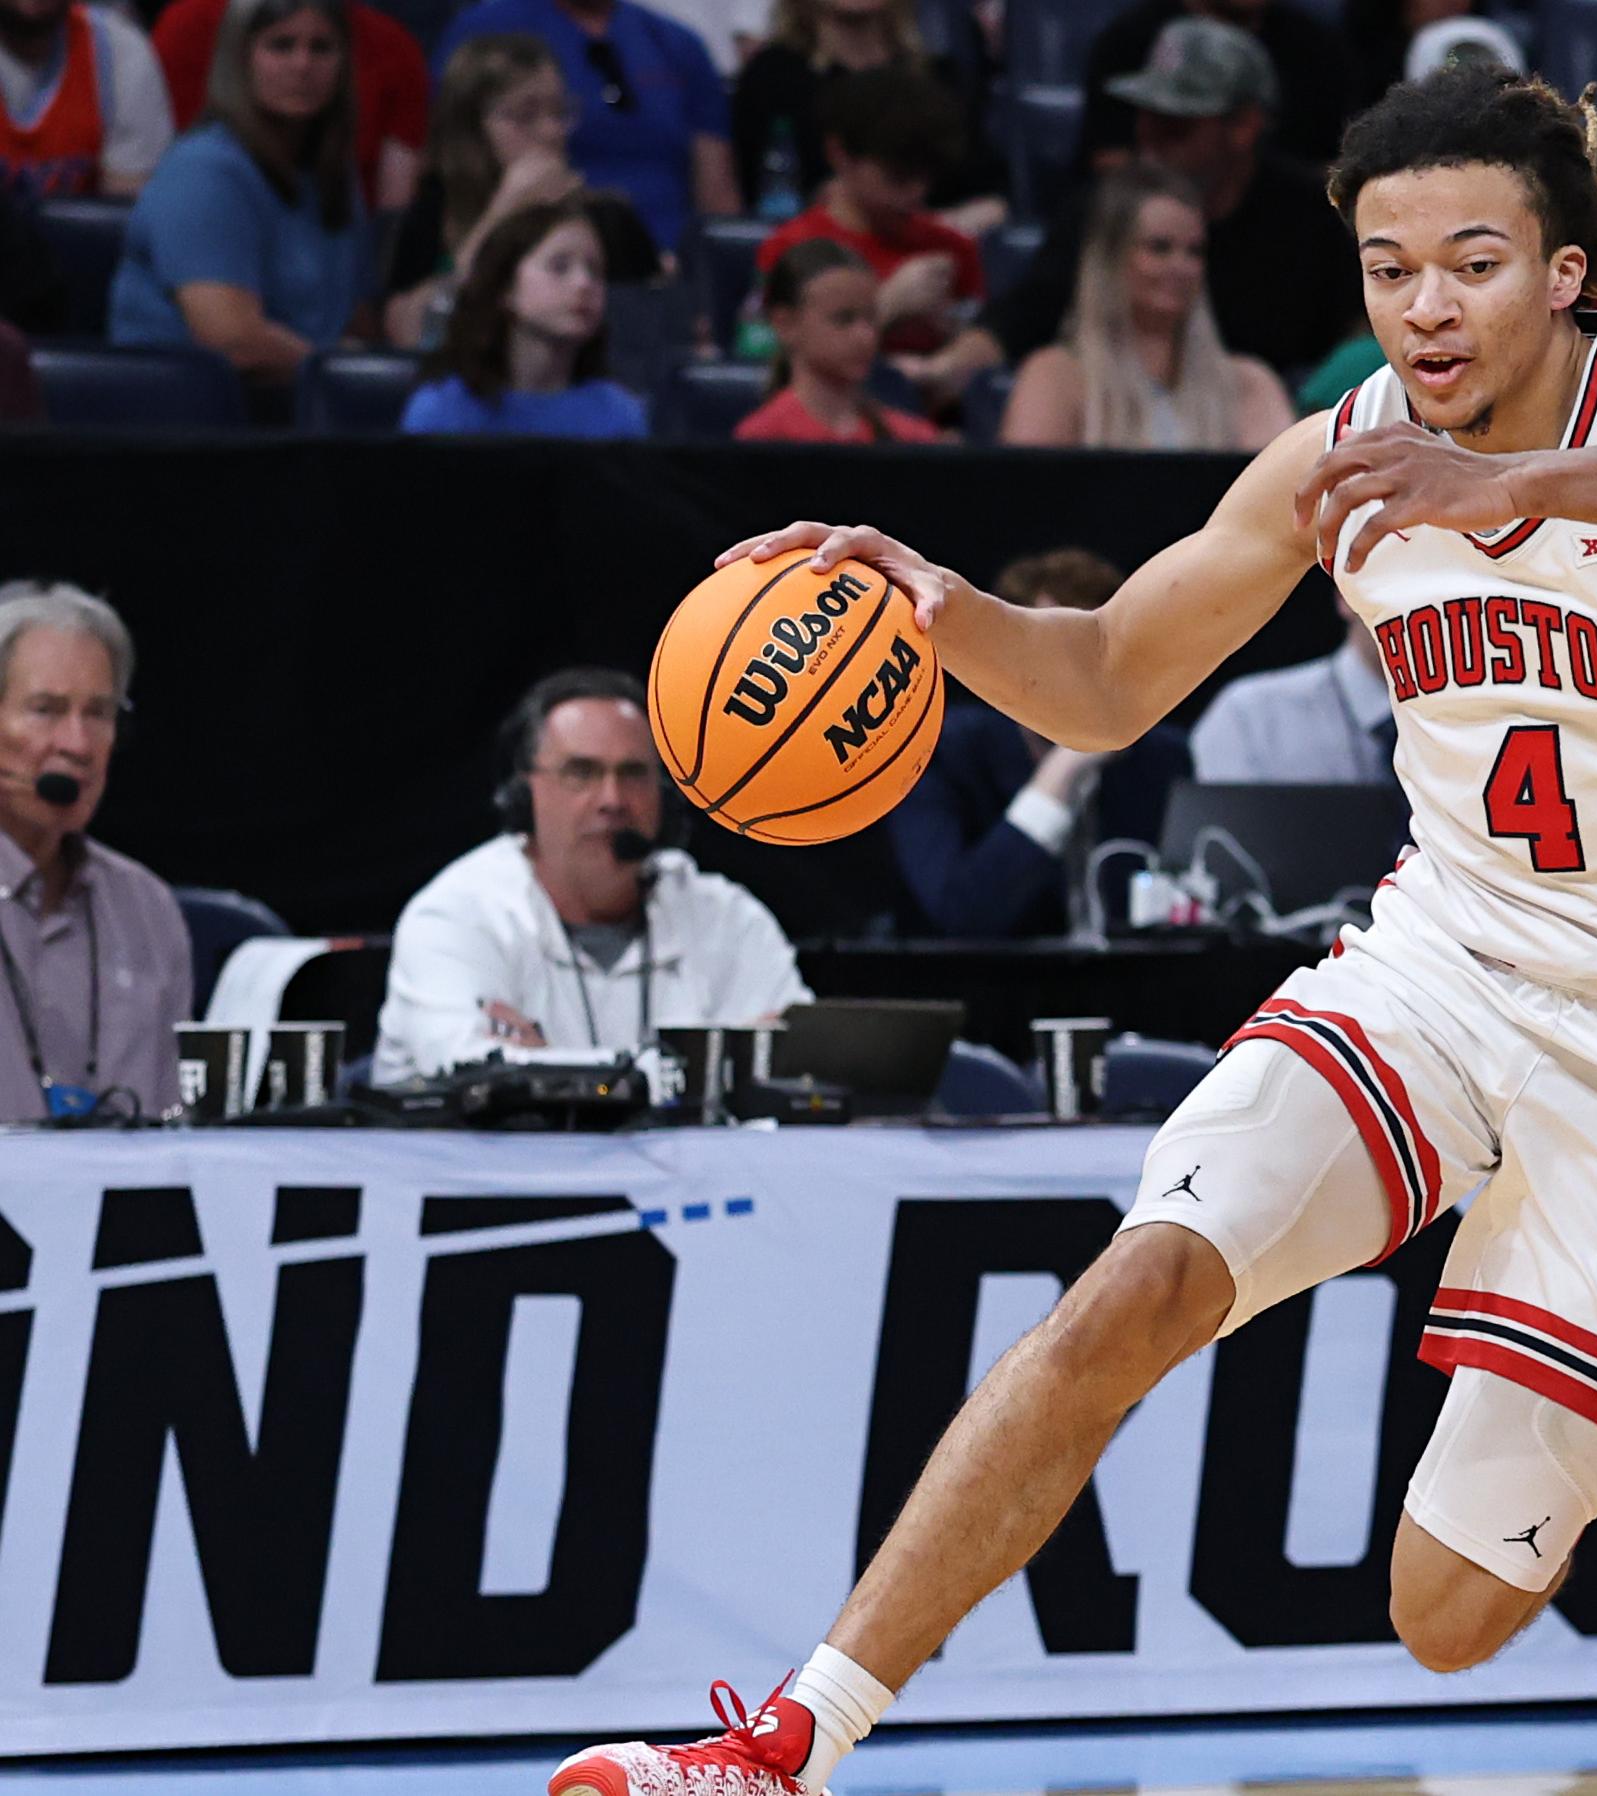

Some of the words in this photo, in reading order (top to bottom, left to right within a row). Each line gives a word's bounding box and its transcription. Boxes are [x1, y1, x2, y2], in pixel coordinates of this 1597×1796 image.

[723, 572, 872, 727] Wilson
[807, 648, 829, 676] EVO
[827, 625, 847, 651] NXT
[823, 634, 921, 765] NCAA
[843, 729, 890, 774] OFFICIAL
[1482, 724, 1587, 873] 4
[0, 1186, 678, 1685] ND
